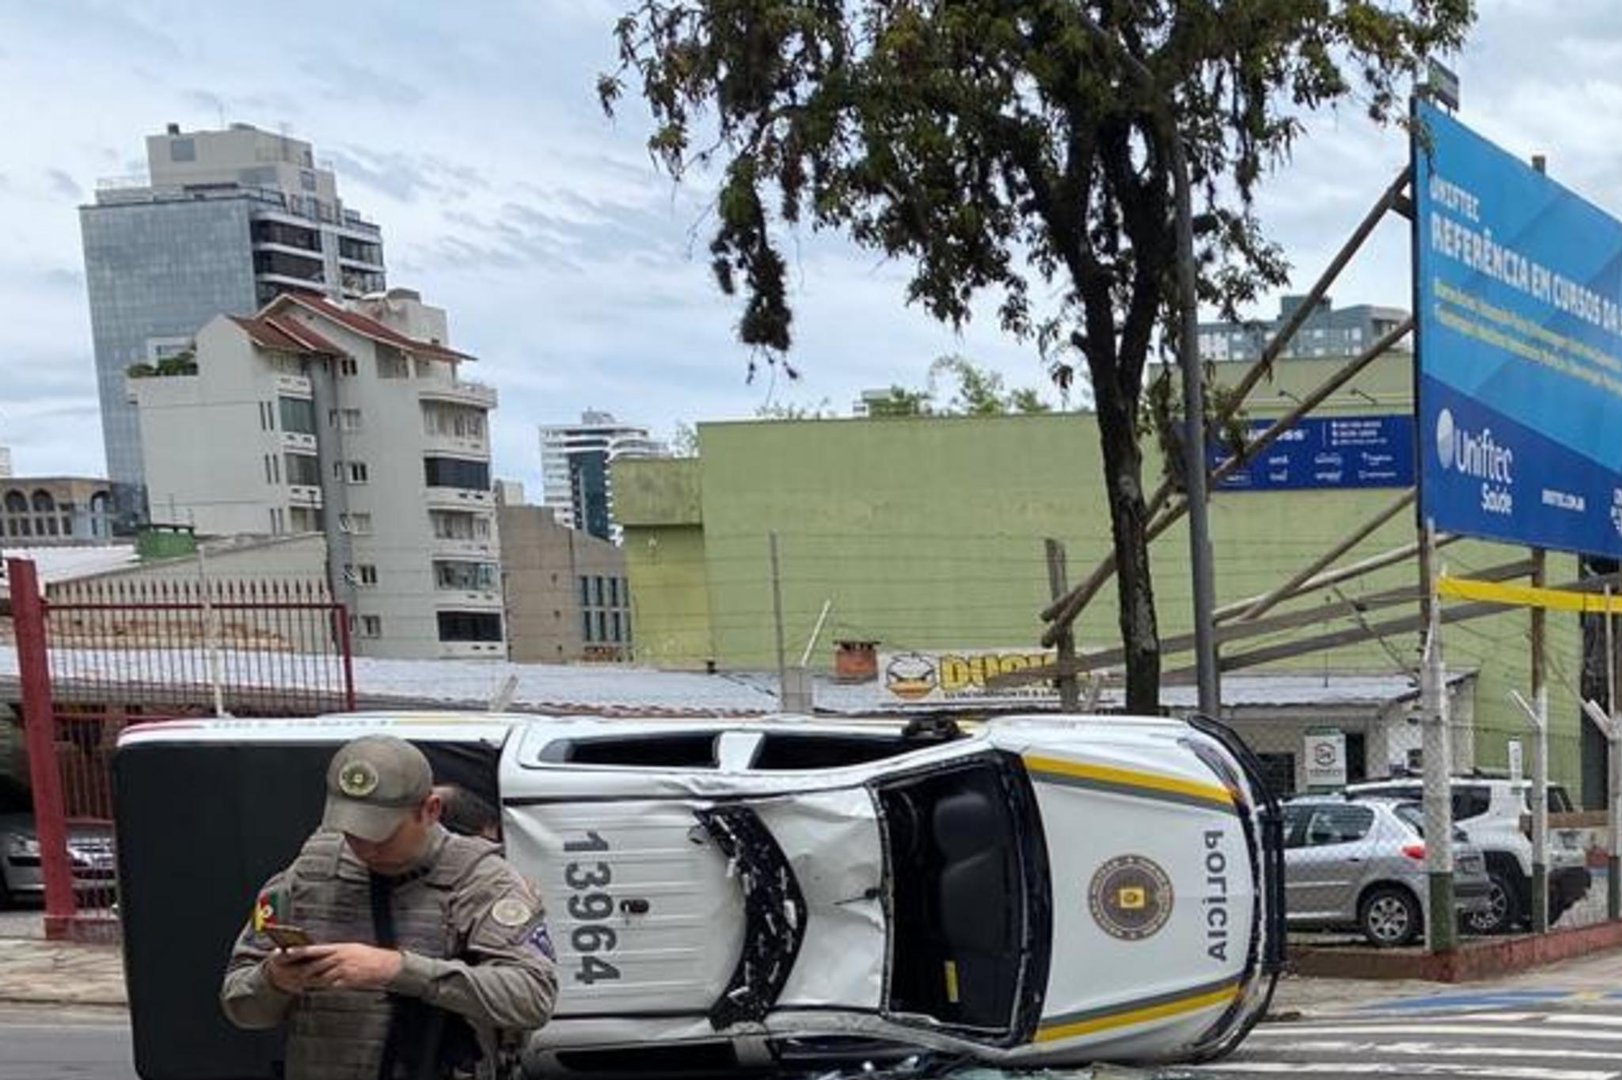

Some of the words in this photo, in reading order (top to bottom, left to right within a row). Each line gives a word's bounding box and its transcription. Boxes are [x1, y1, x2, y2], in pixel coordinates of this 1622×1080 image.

[1431, 211, 1530, 295] REFERÊNCIA
[1531, 263, 1550, 304] EM
[1553, 273, 1600, 326] CURSOS
[1602, 297, 1619, 334] DA
[1455, 428, 1512, 484] Uniftec
[563, 831, 621, 985] 13964
